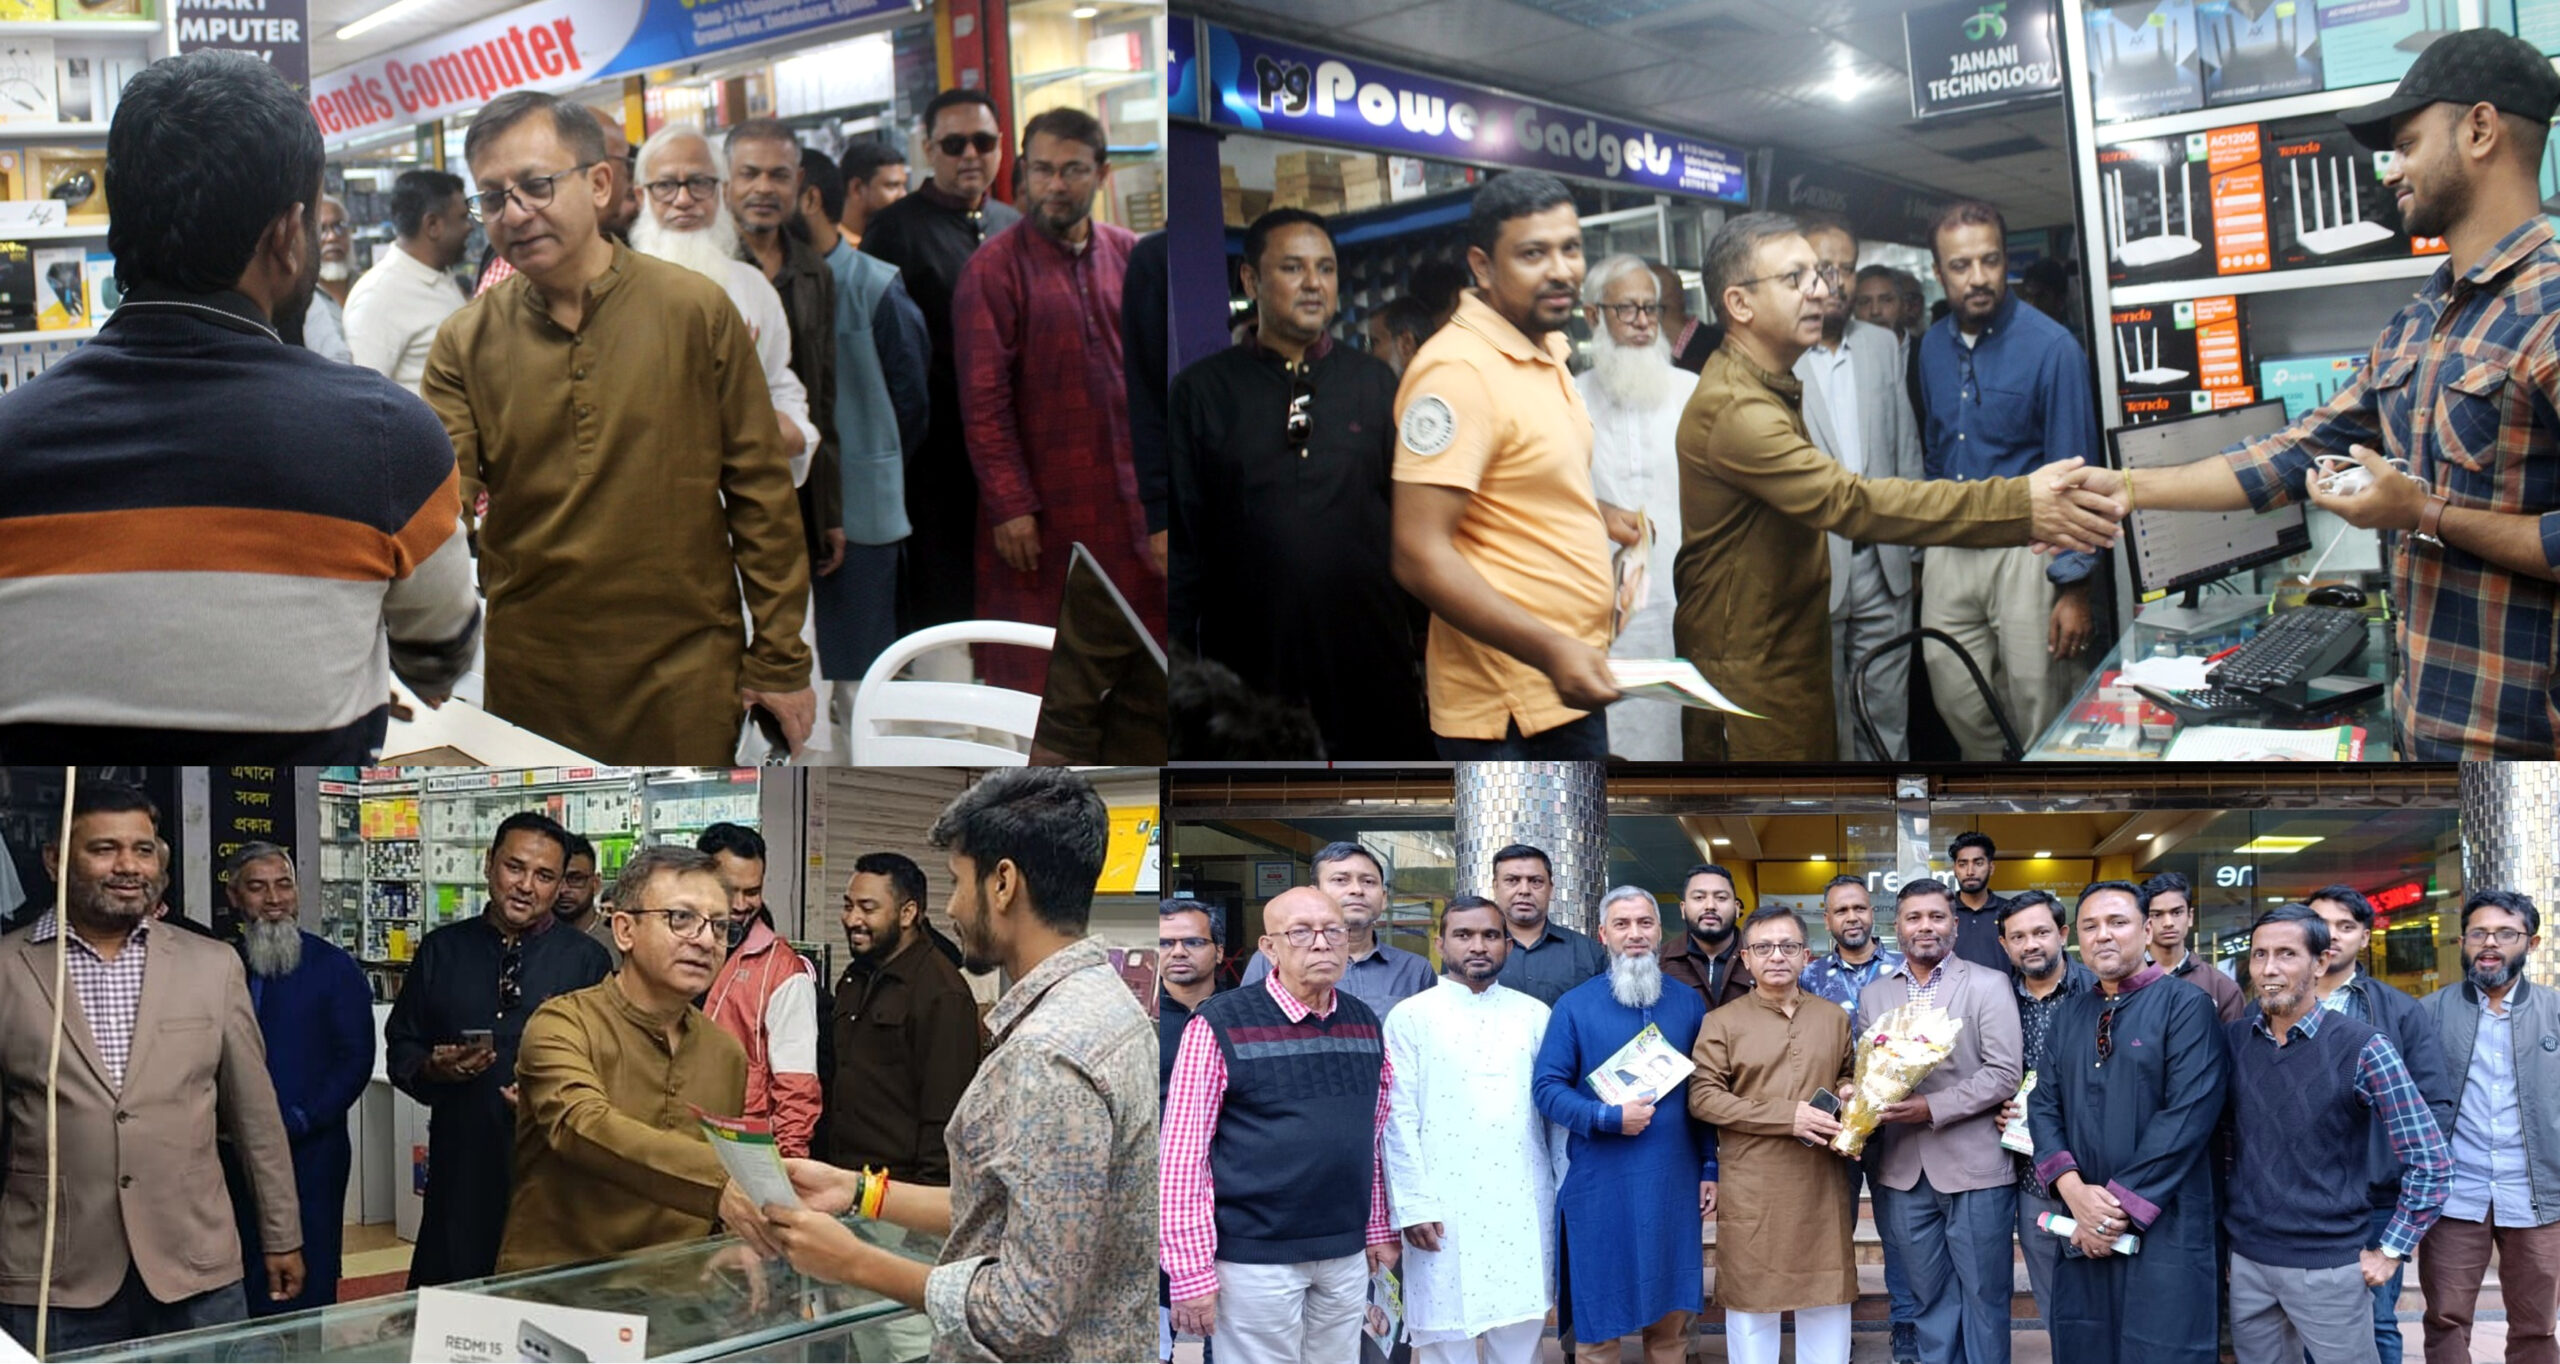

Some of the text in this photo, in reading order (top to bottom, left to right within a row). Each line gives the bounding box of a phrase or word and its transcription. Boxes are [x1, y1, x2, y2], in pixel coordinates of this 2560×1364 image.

[180, 17, 301, 43] MPUTER
[1950, 44, 2018, 75] JANANI
[310, 17, 584, 136] iends Computer
[1928, 62, 2051, 101] TECHNOLOGY
[1316, 59, 1673, 178] Power Gadgets
[2210, 131, 2256, 147] AC1200
[2278, 141, 2321, 157] Tenda
[2126, 397, 2169, 413] Tenda
[234, 791, 270, 807] সকল
[232, 817, 273, 833] প্রকার
[445, 1335, 503, 1355] REDMI 15
